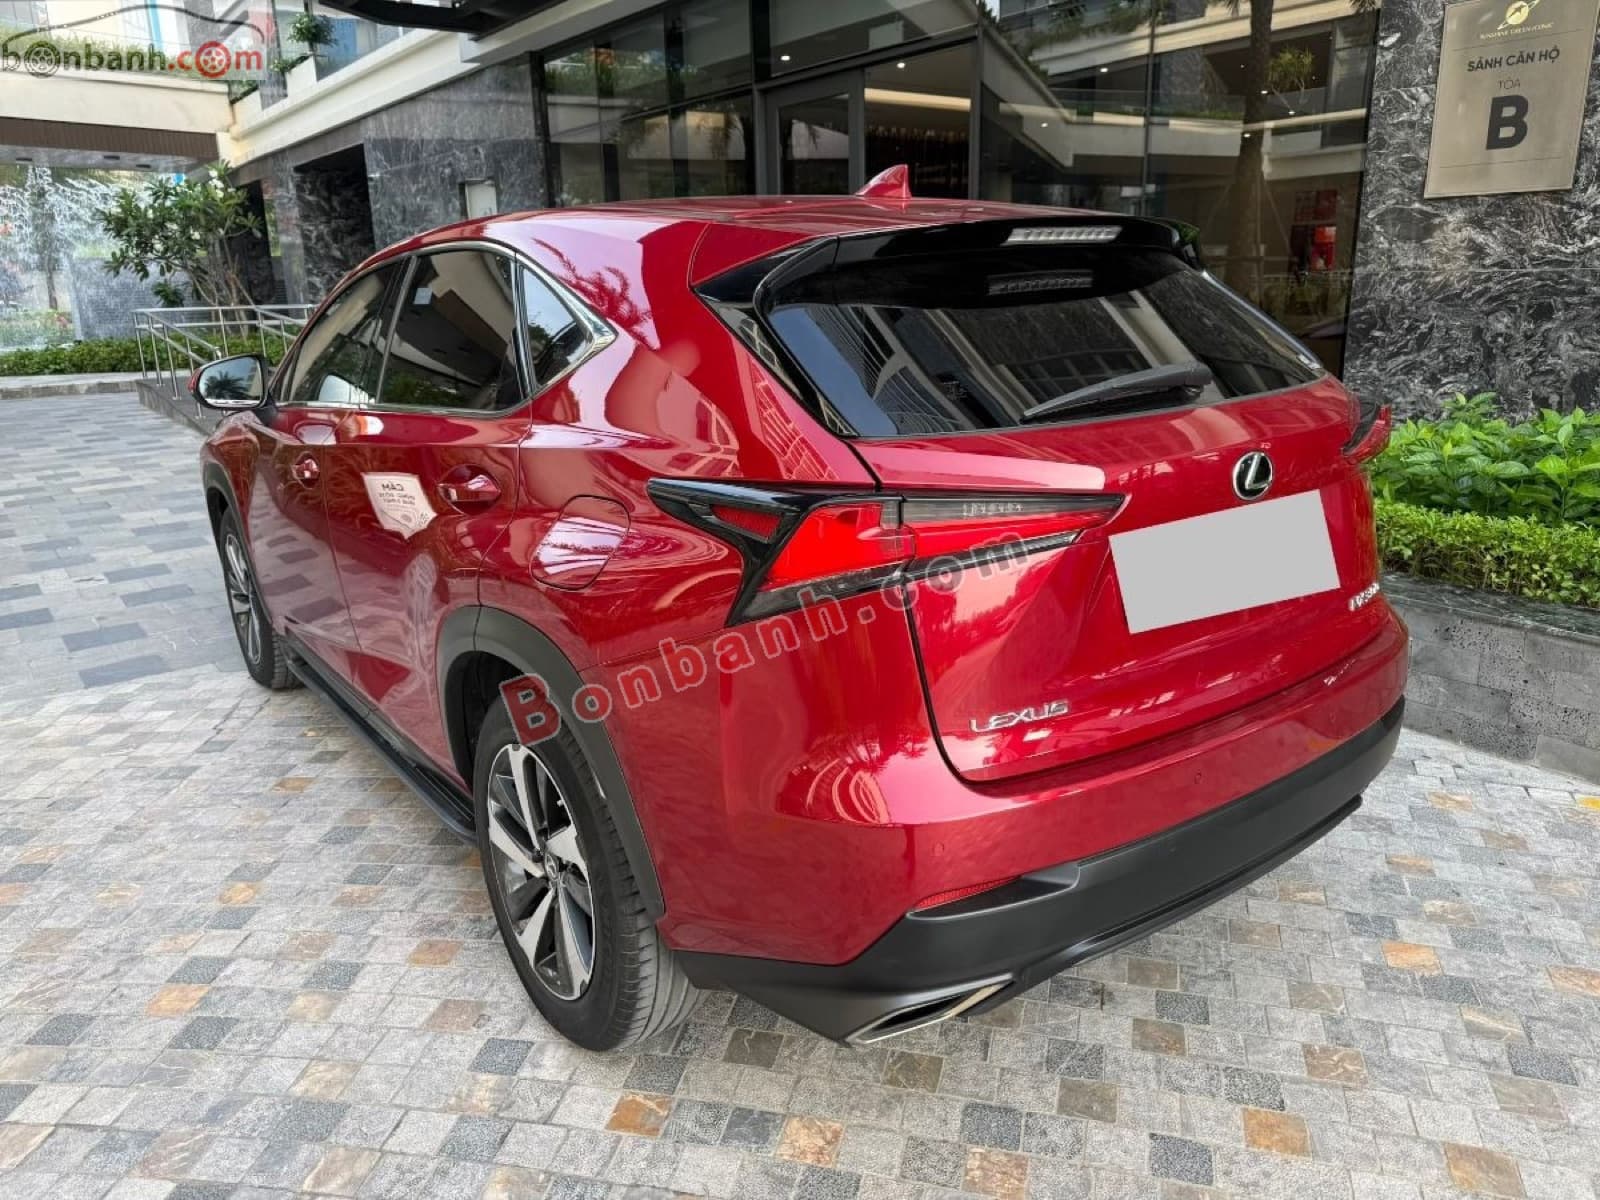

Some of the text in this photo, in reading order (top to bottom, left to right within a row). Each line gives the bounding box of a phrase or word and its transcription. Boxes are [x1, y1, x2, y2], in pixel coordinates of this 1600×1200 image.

[1467, 45, 1561, 73] SẢNH CĂN HỘ
[1486, 95, 1529, 150] B
[968, 698, 1069, 734] LEXUS
